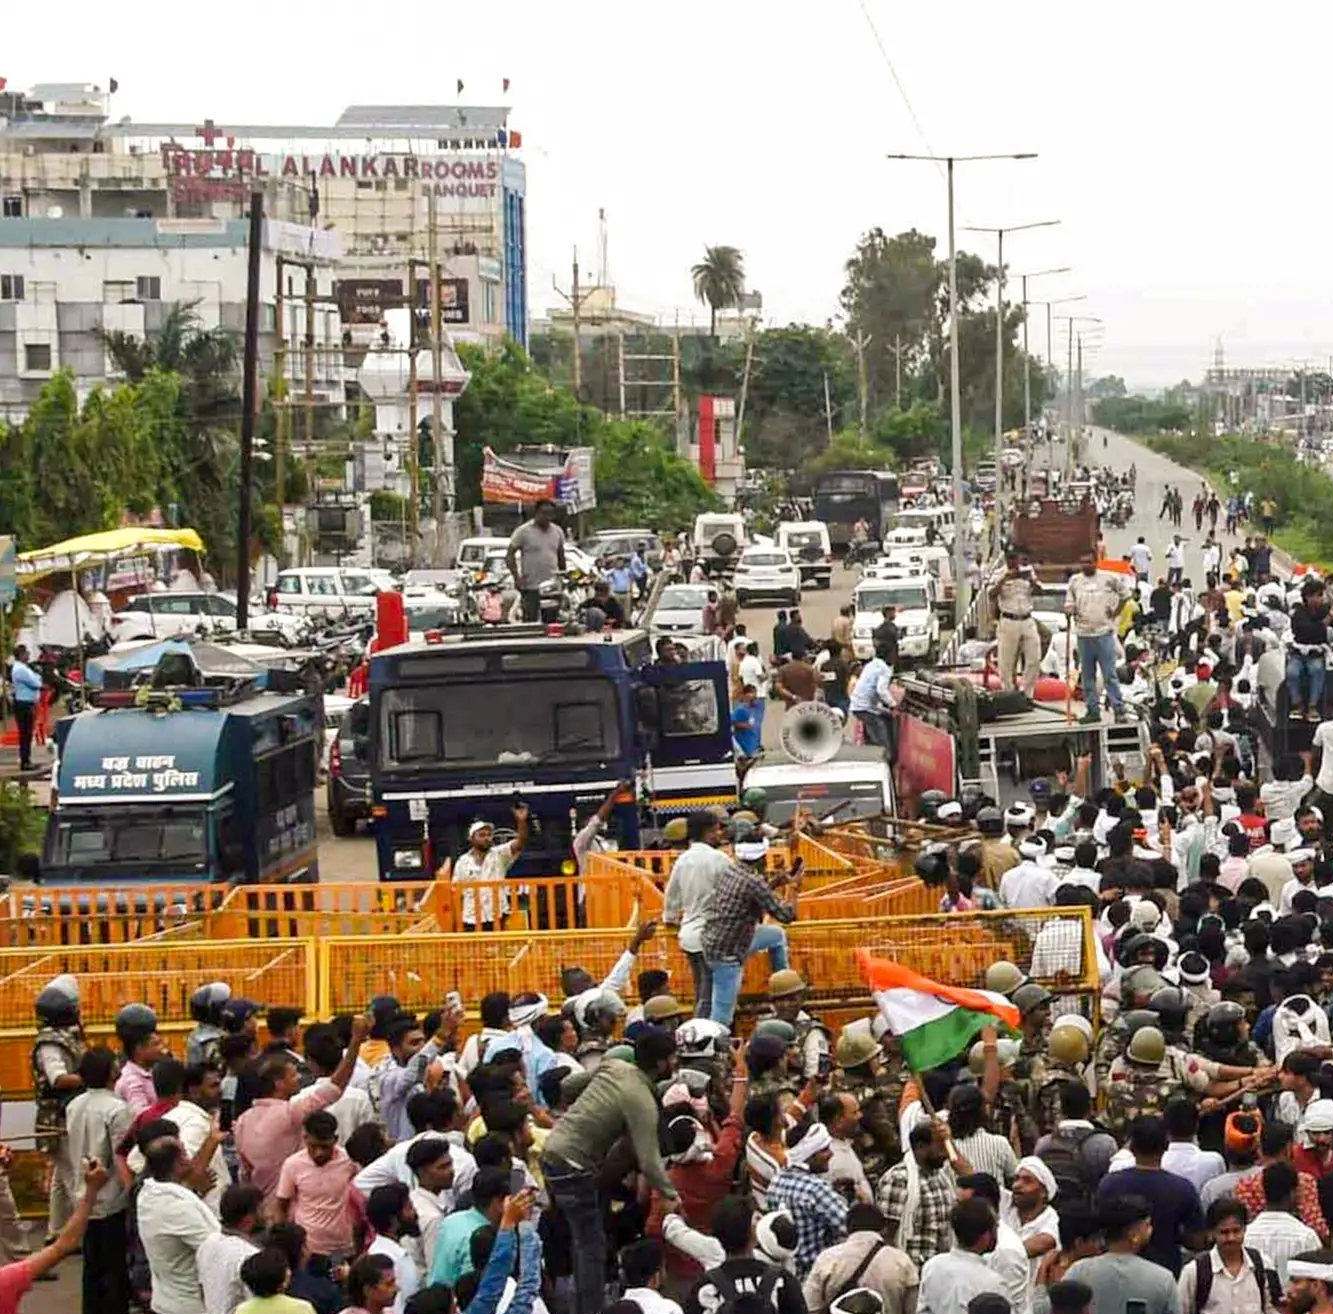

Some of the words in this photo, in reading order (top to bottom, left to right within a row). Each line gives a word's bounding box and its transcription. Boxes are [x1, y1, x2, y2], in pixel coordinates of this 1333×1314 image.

[281, 153, 420, 179] ALANKAR
[422, 160, 498, 180] ROOMS
[101, 756, 131, 771] वज्र
[135, 755, 176, 770] वाहन
[73, 774, 107, 790] मध्य
[110, 771, 148, 788] प्रदेश
[152, 769, 199, 792] पुलिस
